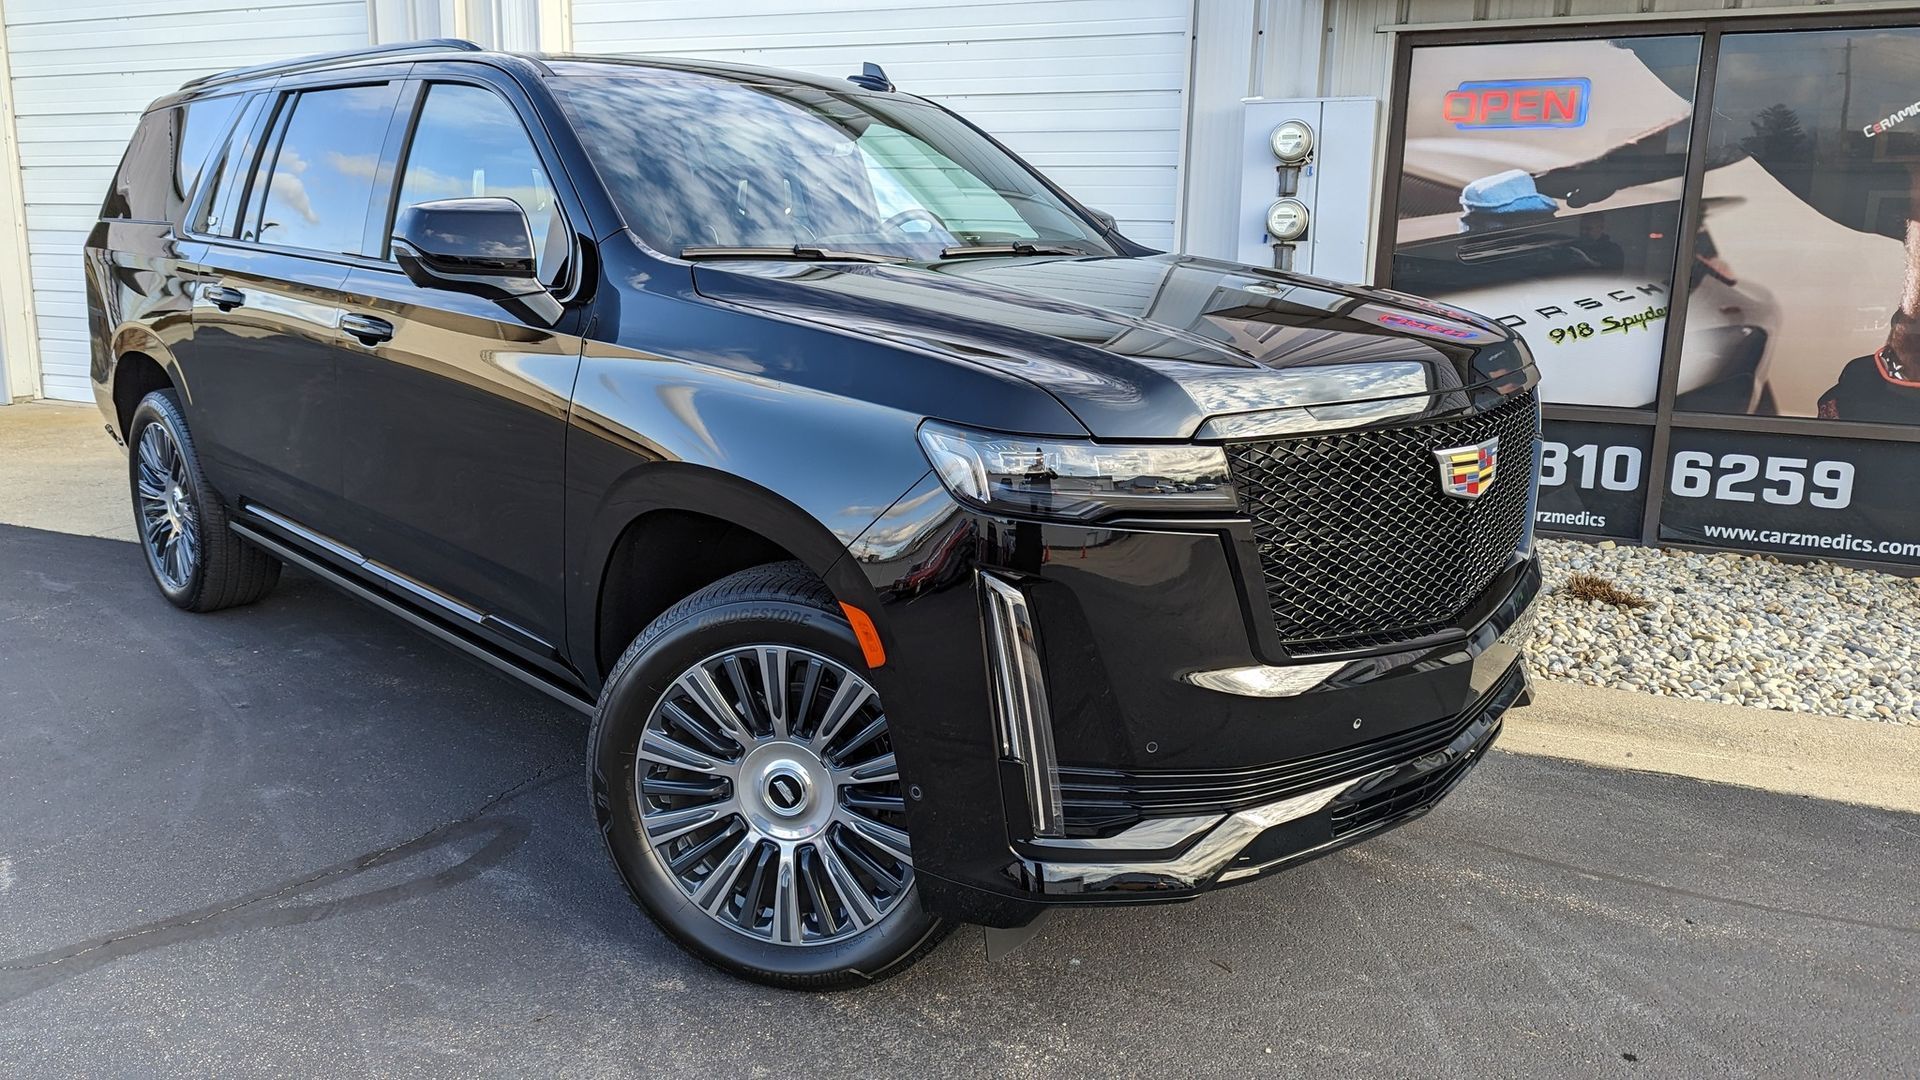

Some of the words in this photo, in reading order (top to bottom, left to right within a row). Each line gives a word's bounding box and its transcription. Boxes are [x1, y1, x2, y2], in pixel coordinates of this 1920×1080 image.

[1444, 89, 1576, 123] OPEN
[1549, 321, 1594, 344] 918
[1671, 451, 1855, 509] 6259
[1704, 524, 1920, 557] www.carzmedics.com
